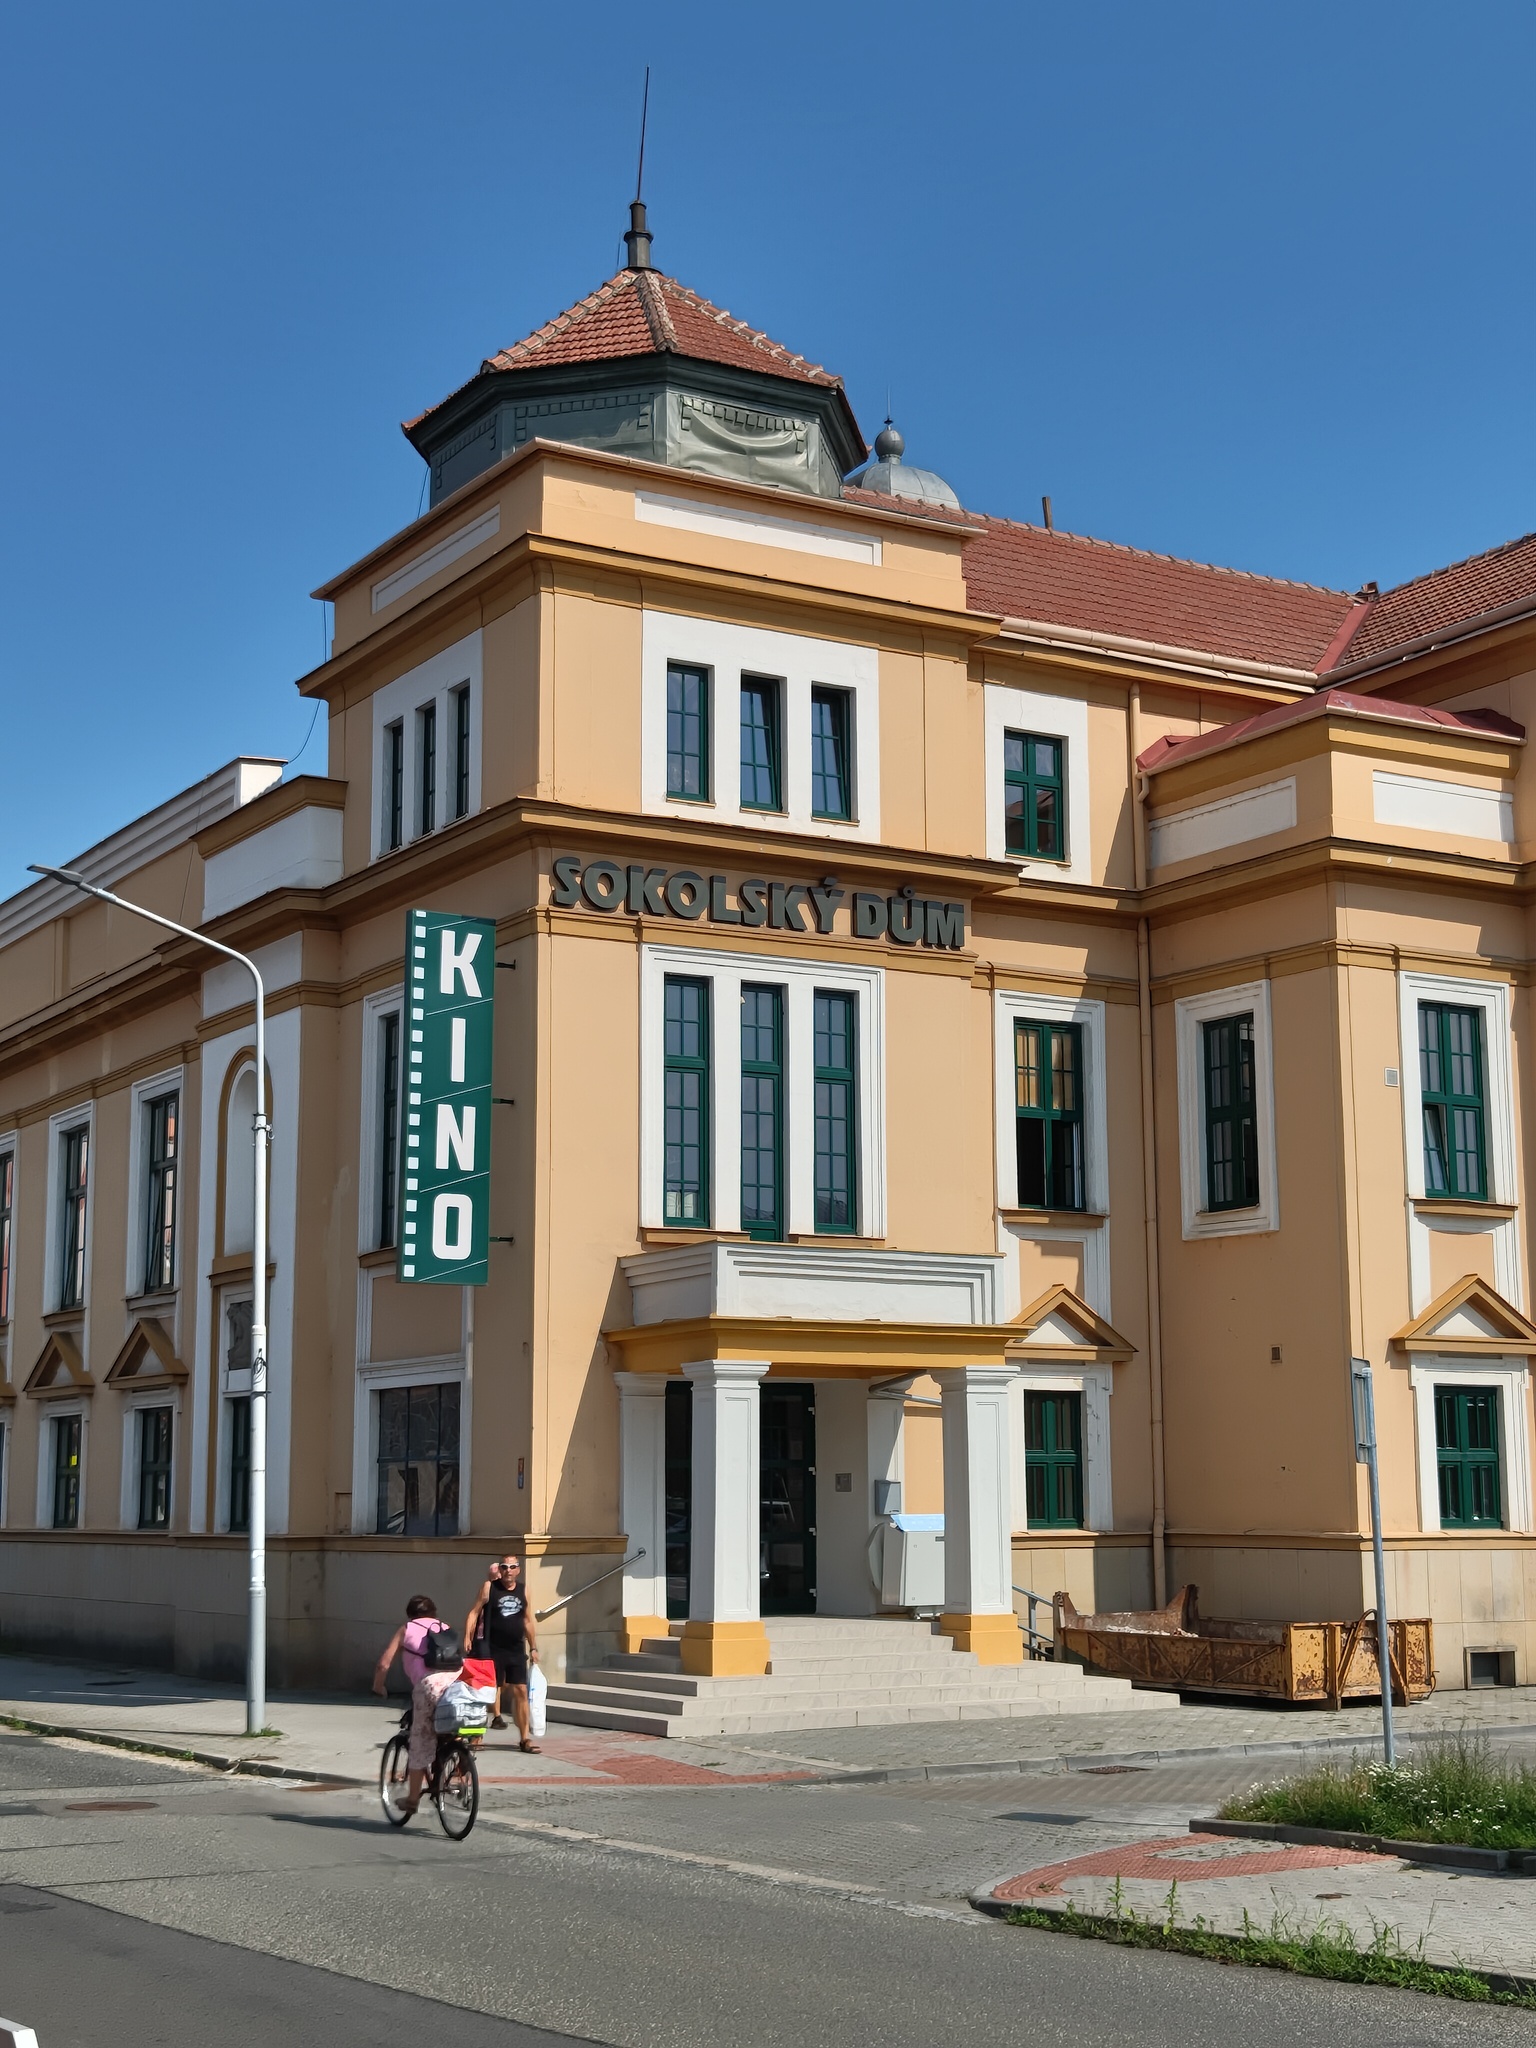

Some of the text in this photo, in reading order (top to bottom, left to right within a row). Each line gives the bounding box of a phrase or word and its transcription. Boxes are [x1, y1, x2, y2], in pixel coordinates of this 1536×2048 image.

[551, 856, 965, 949] SOKOLSKÝ DŮM
[431, 929, 483, 1260] KINO
